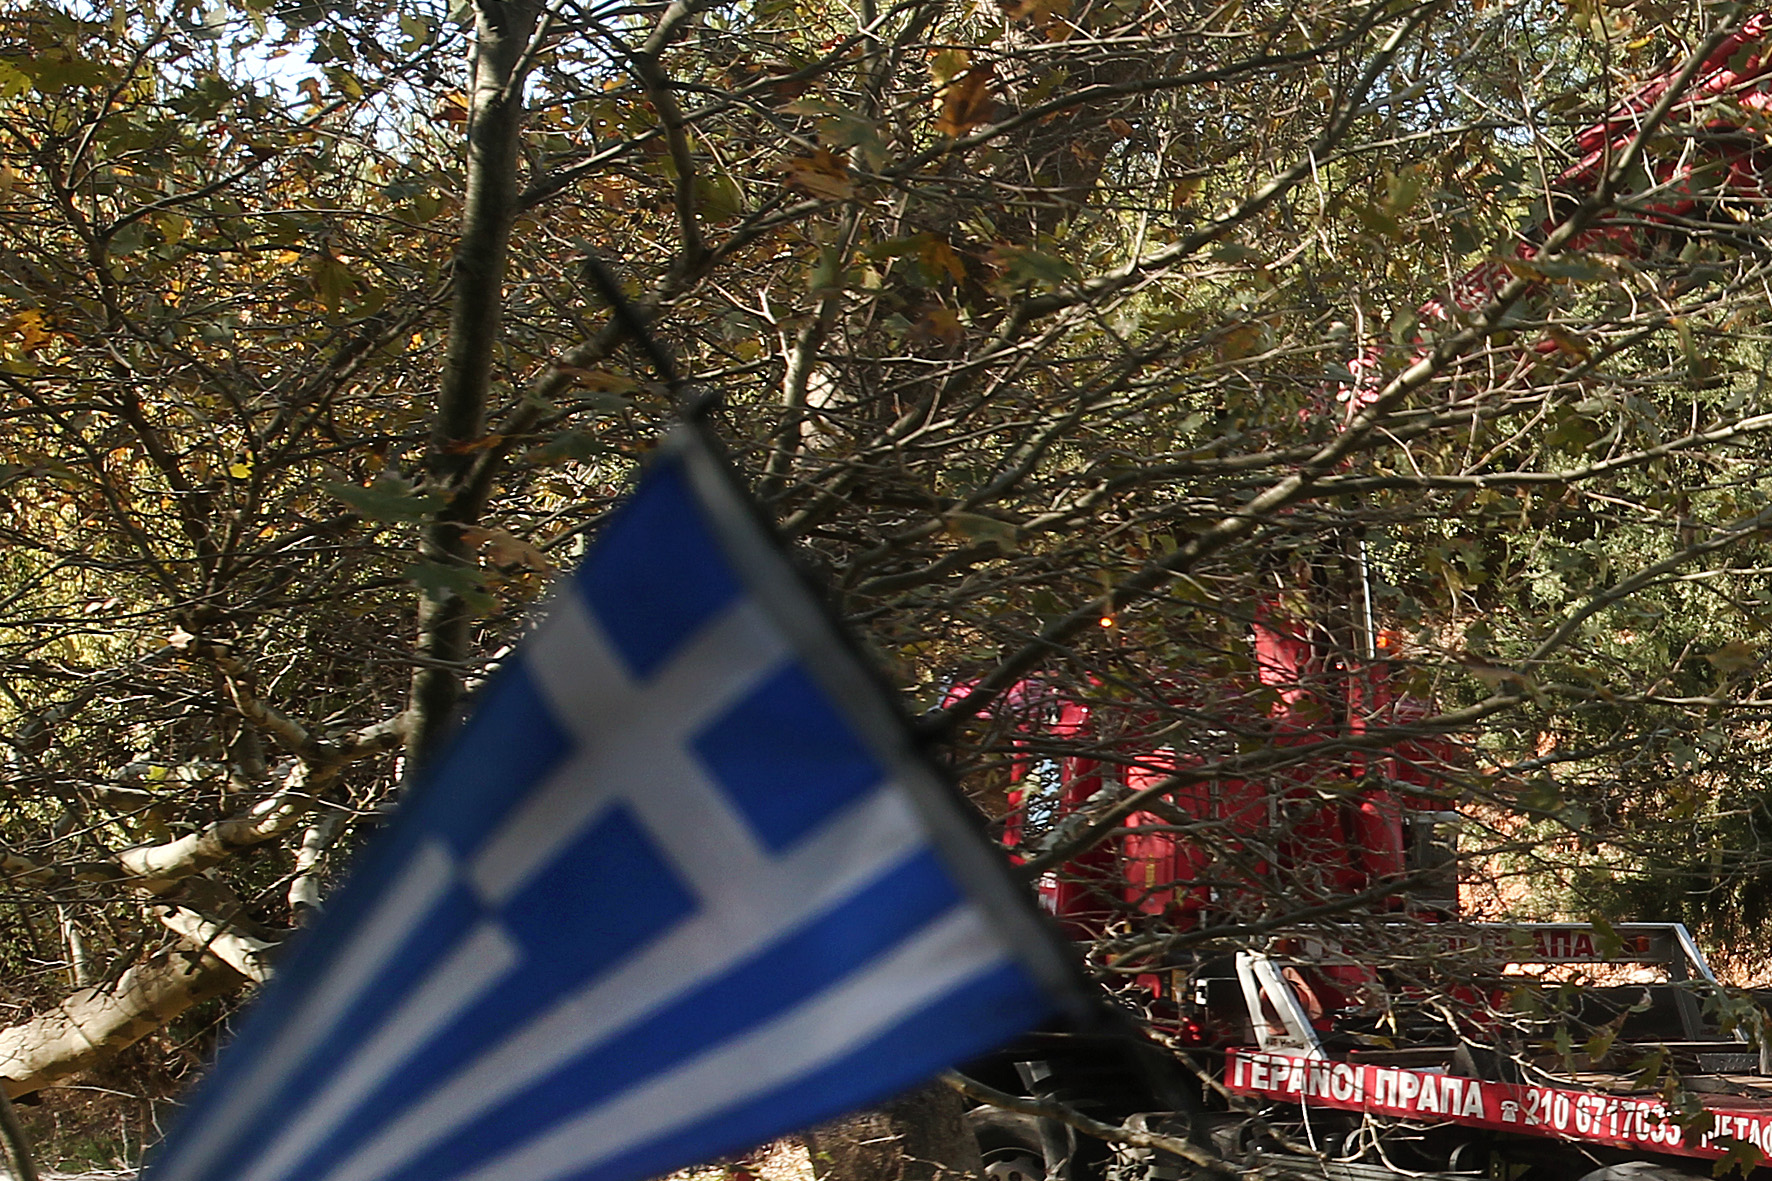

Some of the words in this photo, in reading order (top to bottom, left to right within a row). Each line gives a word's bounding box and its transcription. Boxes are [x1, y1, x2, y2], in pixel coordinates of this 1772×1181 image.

[1233, 1052, 1364, 1102] ΓΕΡΑΝΟΙ
[1374, 1074, 1485, 1120] ΠΡΑΠΑ
[1525, 1088, 1569, 1131] 210
